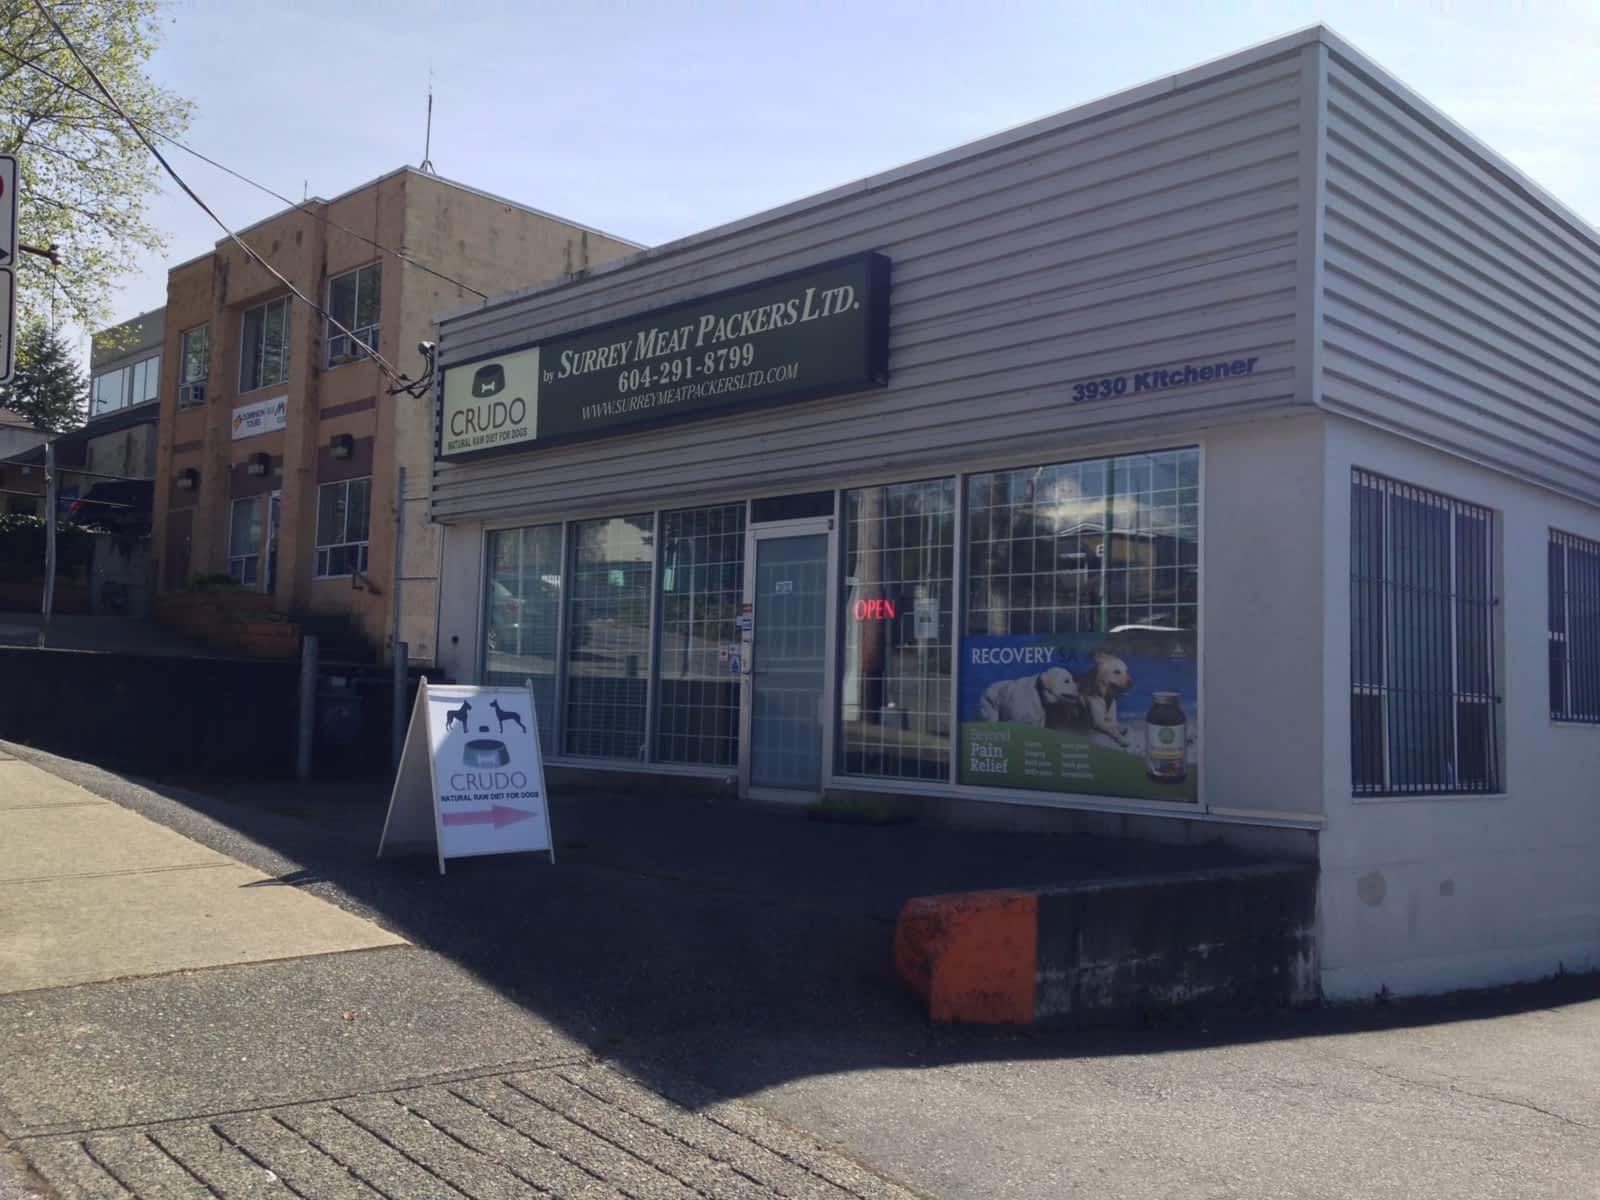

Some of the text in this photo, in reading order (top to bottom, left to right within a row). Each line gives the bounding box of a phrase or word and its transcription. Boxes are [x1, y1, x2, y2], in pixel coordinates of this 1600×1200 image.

[543, 284, 860, 384] by SURREY MEAT PACKERS LTD.
[618, 343, 754, 393] 604-291-8799
[1072, 357, 1259, 402] 3930 Kitchener
[450, 397, 526, 437] CRUDO
[448, 427, 527, 450] NATURAL RAW DIET FOR DOGS
[853, 598, 896, 621] OPEN
[971, 645, 1055, 665] RECOVERY
[970, 742, 1003, 758] Pain
[969, 758, 1009, 774] Relief
[450, 771, 526, 791] CRUDO
[473, 793, 490, 801] RAW
[490, 793, 505, 801] DIET
[520, 791, 539, 799] DOGS
